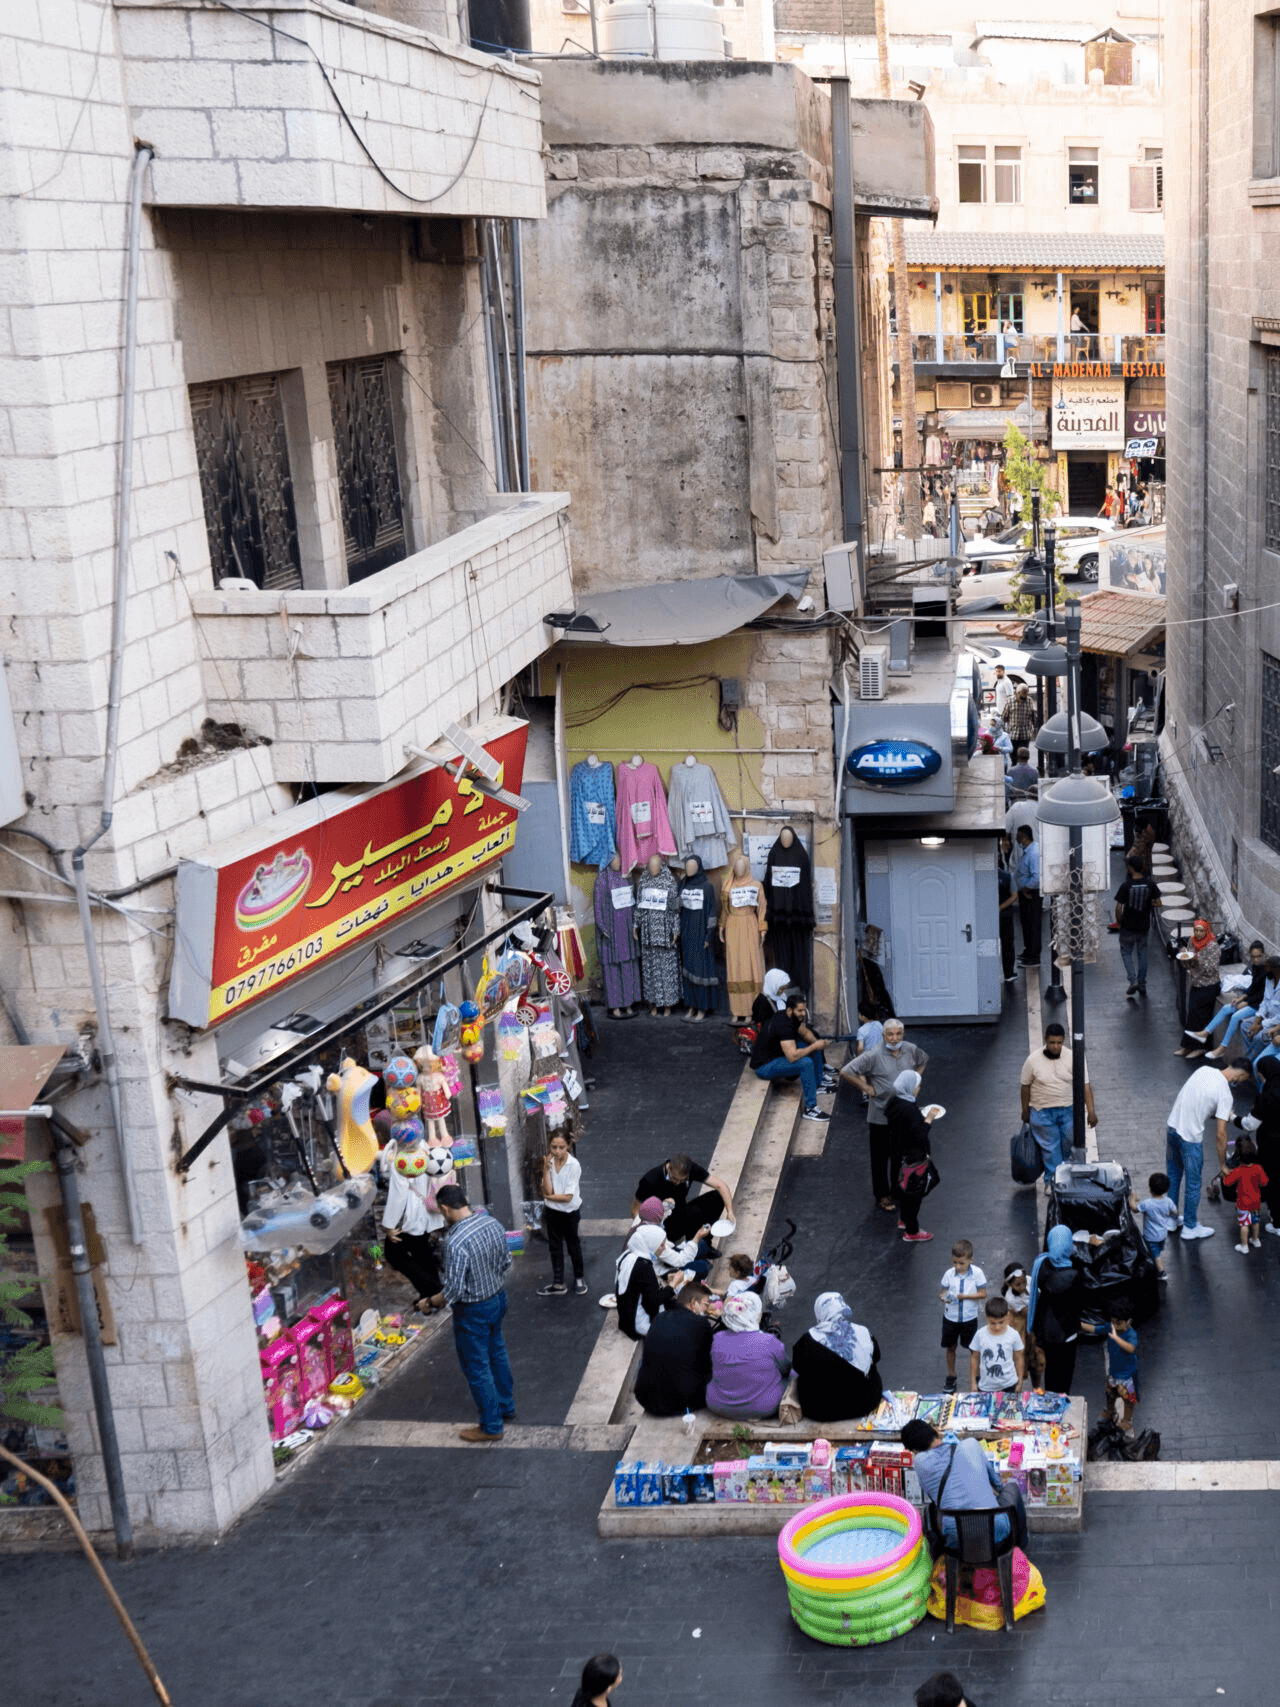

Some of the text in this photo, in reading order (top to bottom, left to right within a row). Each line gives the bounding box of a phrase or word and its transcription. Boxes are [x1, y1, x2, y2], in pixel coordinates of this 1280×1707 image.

[1053, 363, 1111, 377] MADENAH
[1096, 396, 1119, 406] مطعم
[1057, 411, 1120, 435] المدينة
[478, 811, 508, 832] جملة
[374, 836, 450, 885] وسط البلد
[471, 826, 510, 862] ألعاب
[410, 864, 454, 899] هدايا
[237, 934, 278, 968] مفرق
[225, 937, 323, 1005] 0797766103
